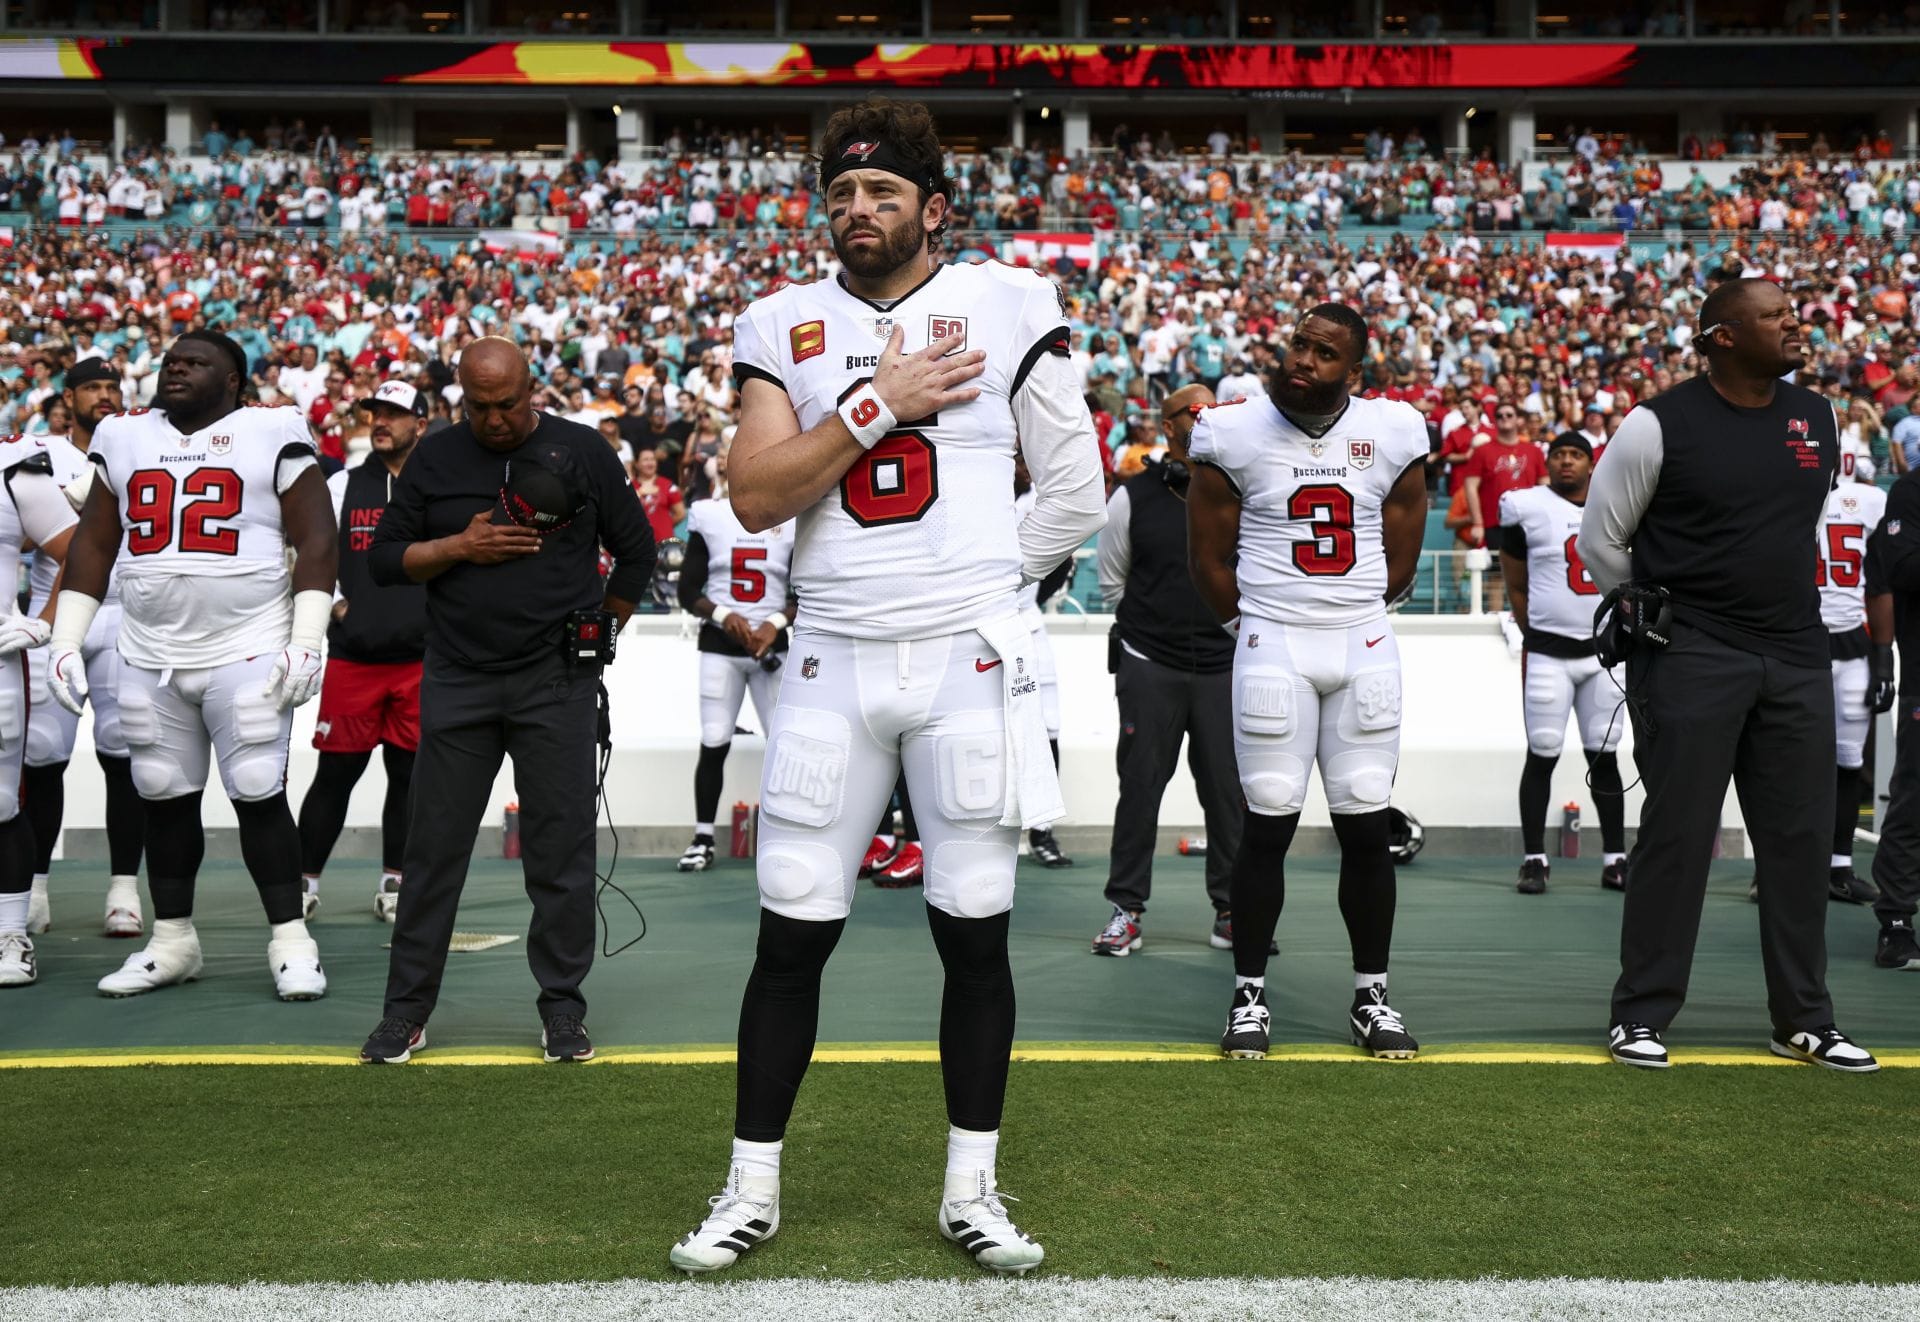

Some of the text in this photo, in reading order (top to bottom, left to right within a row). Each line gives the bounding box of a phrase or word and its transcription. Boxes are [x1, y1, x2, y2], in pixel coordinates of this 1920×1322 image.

[933, 319, 963, 339] 50
[212, 435, 231, 445] 50
[1351, 443, 1372, 457] 50
[1293, 467, 1347, 478] BUCCANEERS
[126, 467, 244, 557] 92
[1287, 483, 1357, 576] 3
[730, 547, 767, 603] 5
[610, 618, 618, 653] SONY
[1646, 630, 1669, 645] SONY
[951, 737, 998, 811] 6
